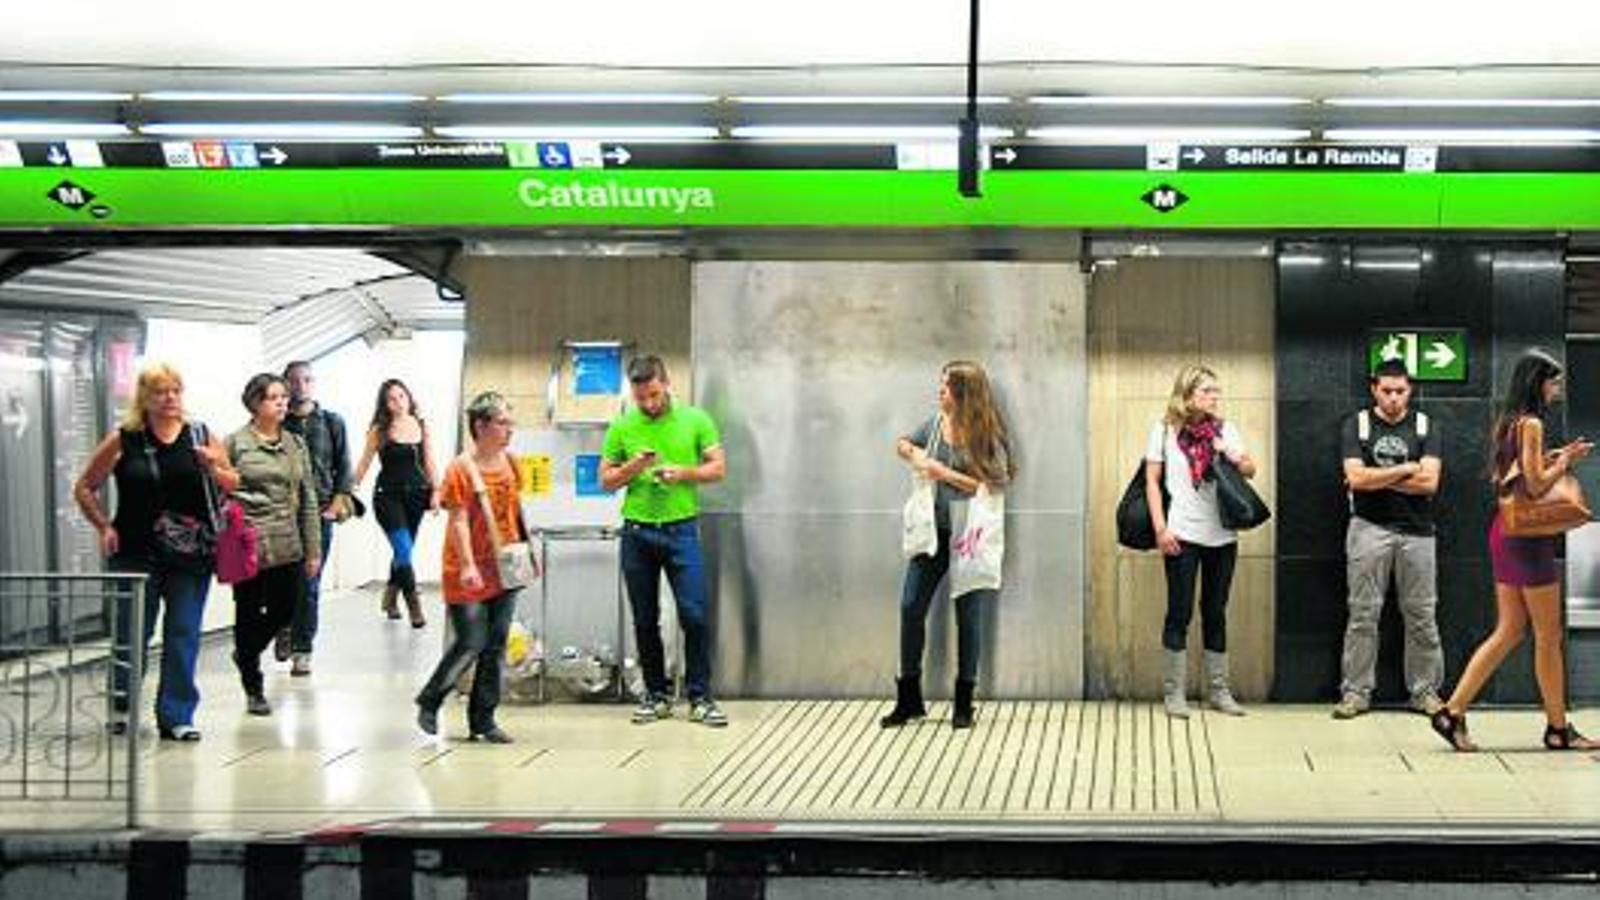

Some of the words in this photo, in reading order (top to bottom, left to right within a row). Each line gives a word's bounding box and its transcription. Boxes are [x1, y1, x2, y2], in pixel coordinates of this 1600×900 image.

[1225, 148, 1288, 164] Salida
[1294, 148, 1319, 164] La
[1324, 148, 1401, 164] Rambla
[58, 187, 85, 204] M
[518, 178, 715, 213] Catalunya
[1153, 190, 1176, 207] M
